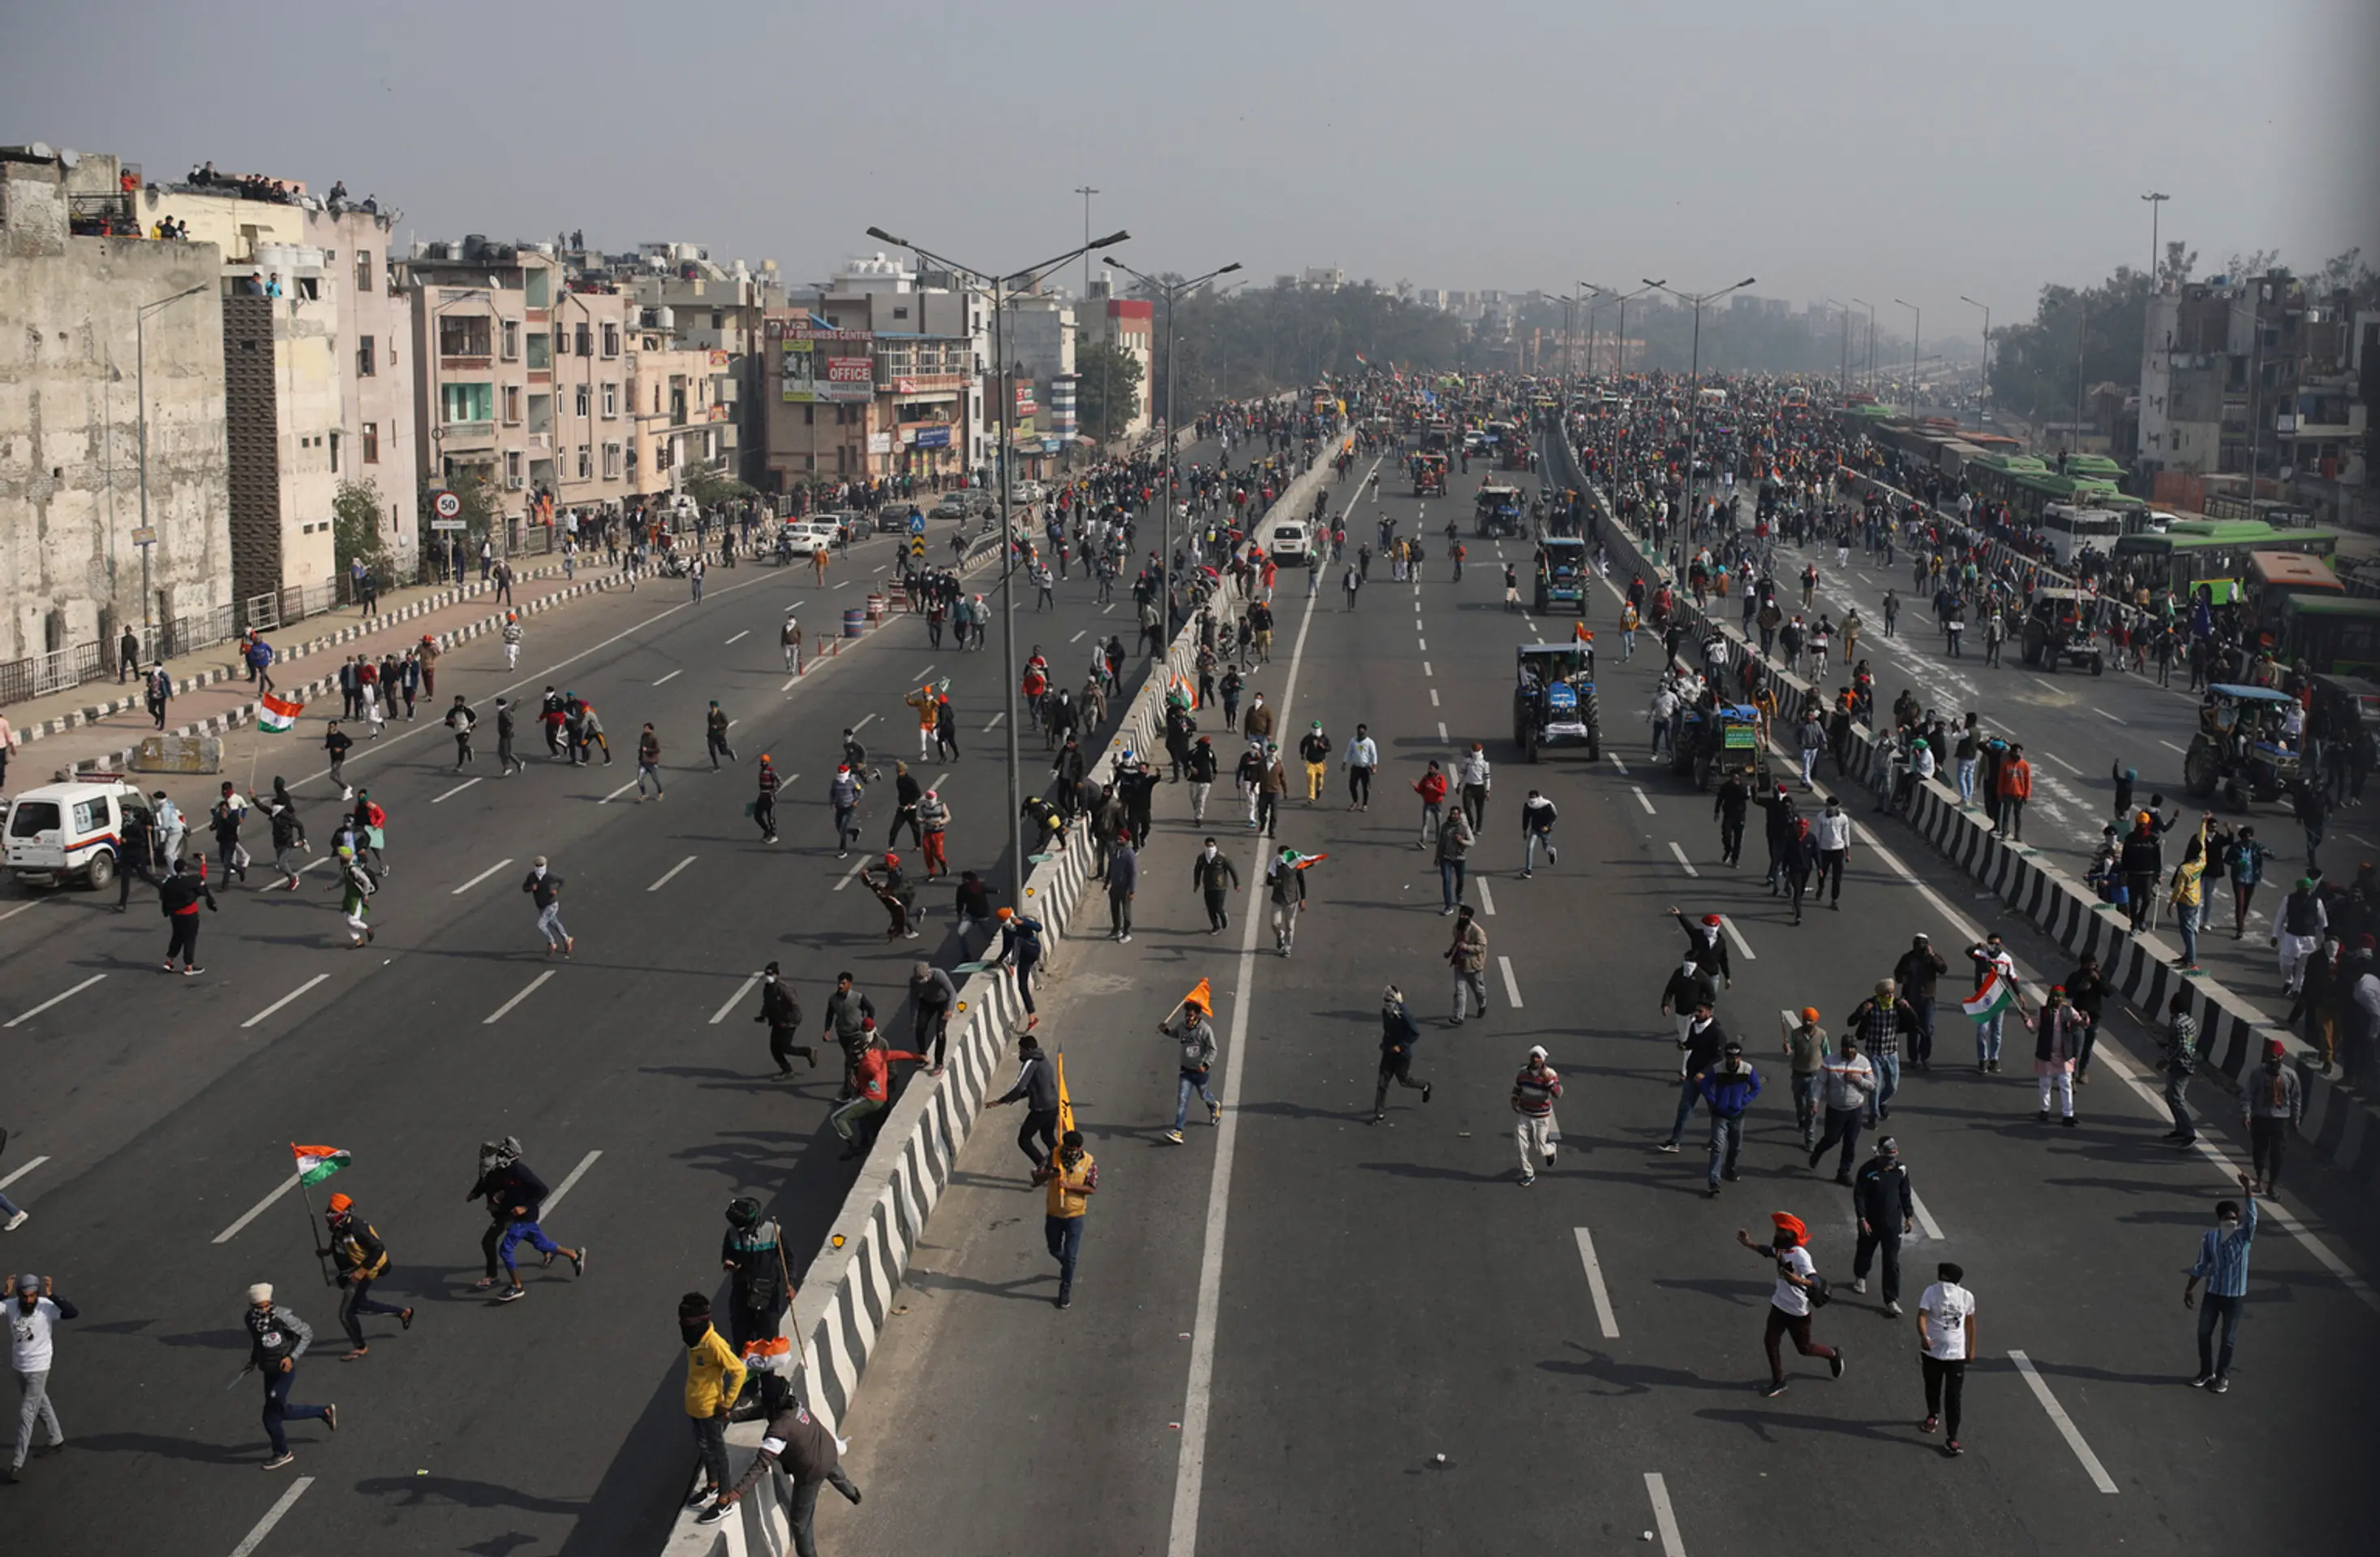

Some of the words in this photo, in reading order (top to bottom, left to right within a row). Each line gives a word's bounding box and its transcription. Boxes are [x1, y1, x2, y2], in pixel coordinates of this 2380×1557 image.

[797, 331, 837, 340] BUSINESS
[839, 331, 873, 340] CENTRE
[830, 367, 870, 381] OFFICE
[441, 499, 456, 511] 50
